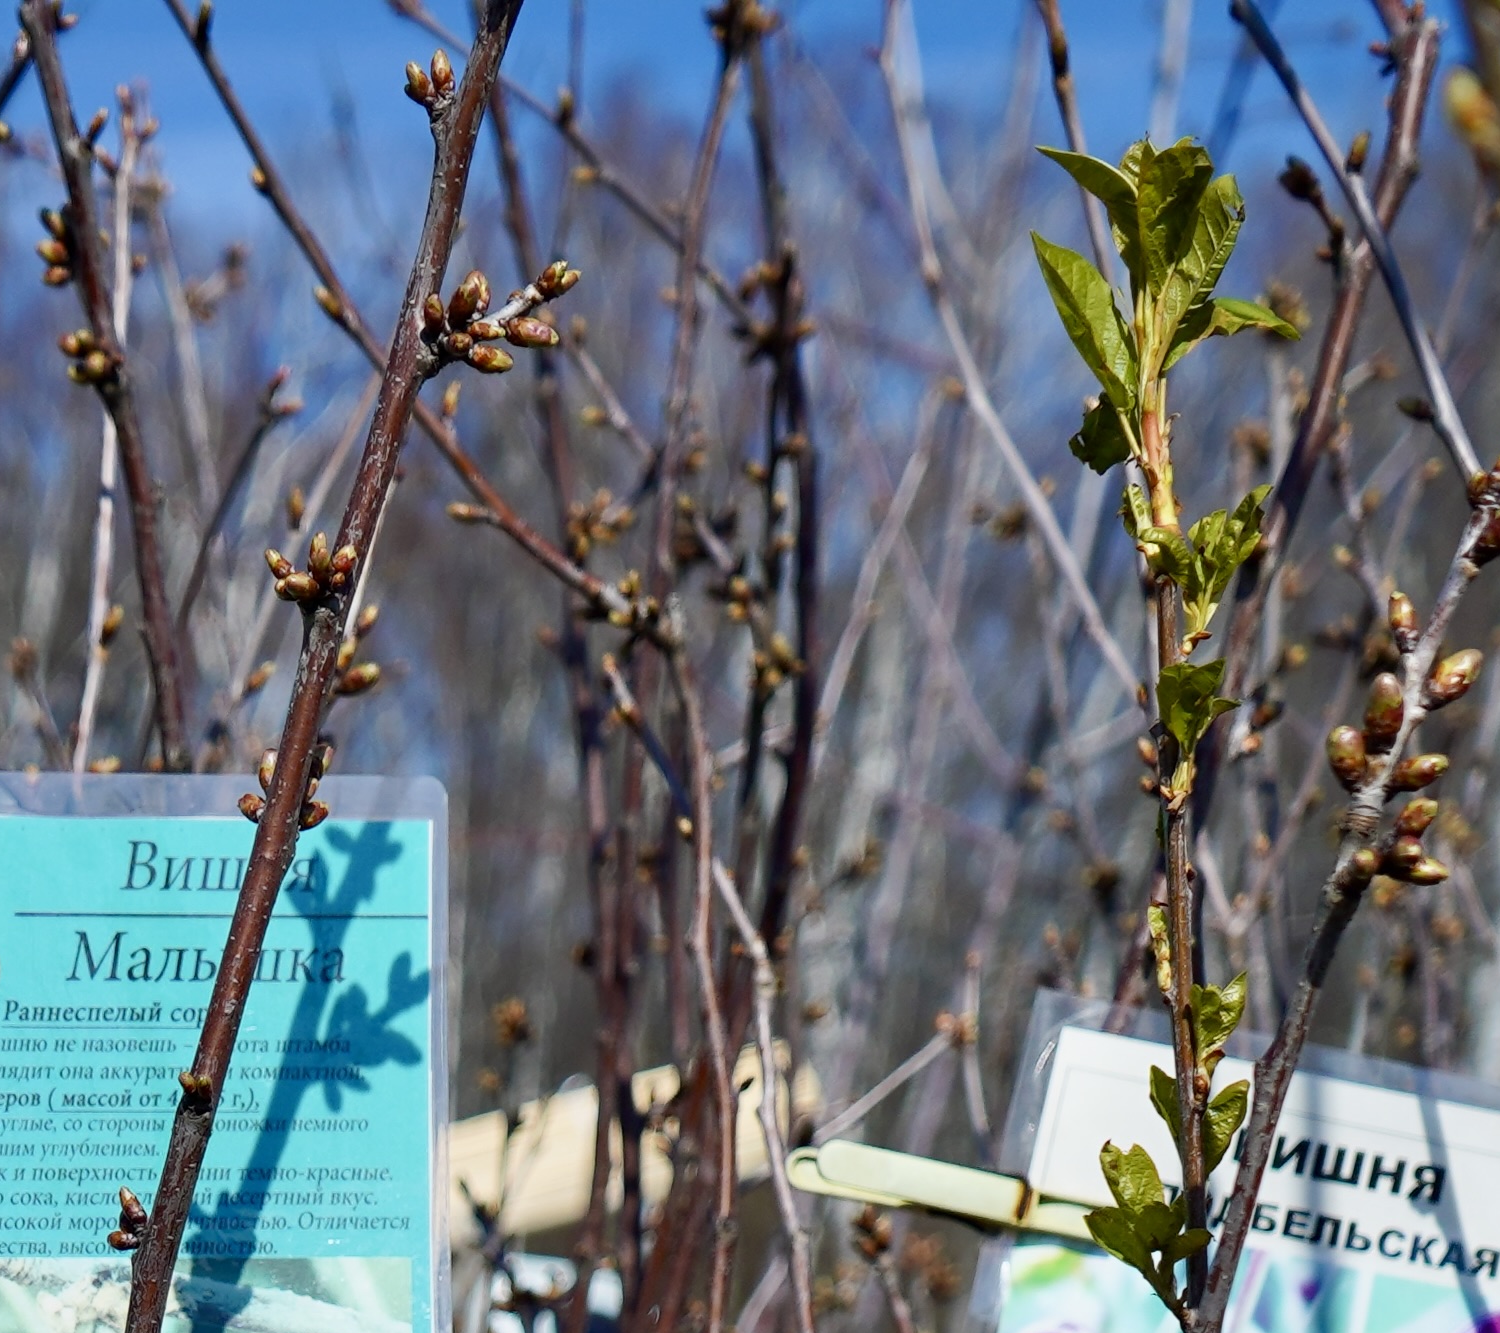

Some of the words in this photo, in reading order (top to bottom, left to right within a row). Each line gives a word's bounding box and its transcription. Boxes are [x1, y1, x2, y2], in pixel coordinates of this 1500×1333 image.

[120, 840, 316, 892] Вишя
[2, 1000, 162, 1022] Раннеспелый
[170, 1006, 211, 1027] сор
[53, 1037, 77, 1052] не
[83, 1037, 177, 1053] назовешь
[59, 1067, 94, 1080] она
[61, 1088, 132, 1107] массой
[139, 1093, 162, 1107] от
[63, 1119, 82, 1132] со
[88, 1118, 165, 1137] стороны
[290, 1118, 369, 1133] немного
[40, 1138, 160, 1162] углублением.
[13, 1166, 25, 1181] и
[31, 1166, 157, 1187] поверхность
[237, 1165, 393, 1187] темно-красные.
[10, 1192, 58, 1208] сока,
[219, 1187, 323, 1208] десертный
[330, 1191, 378, 1210] вкус.
[298, 1211, 410, 1231] Отличается
